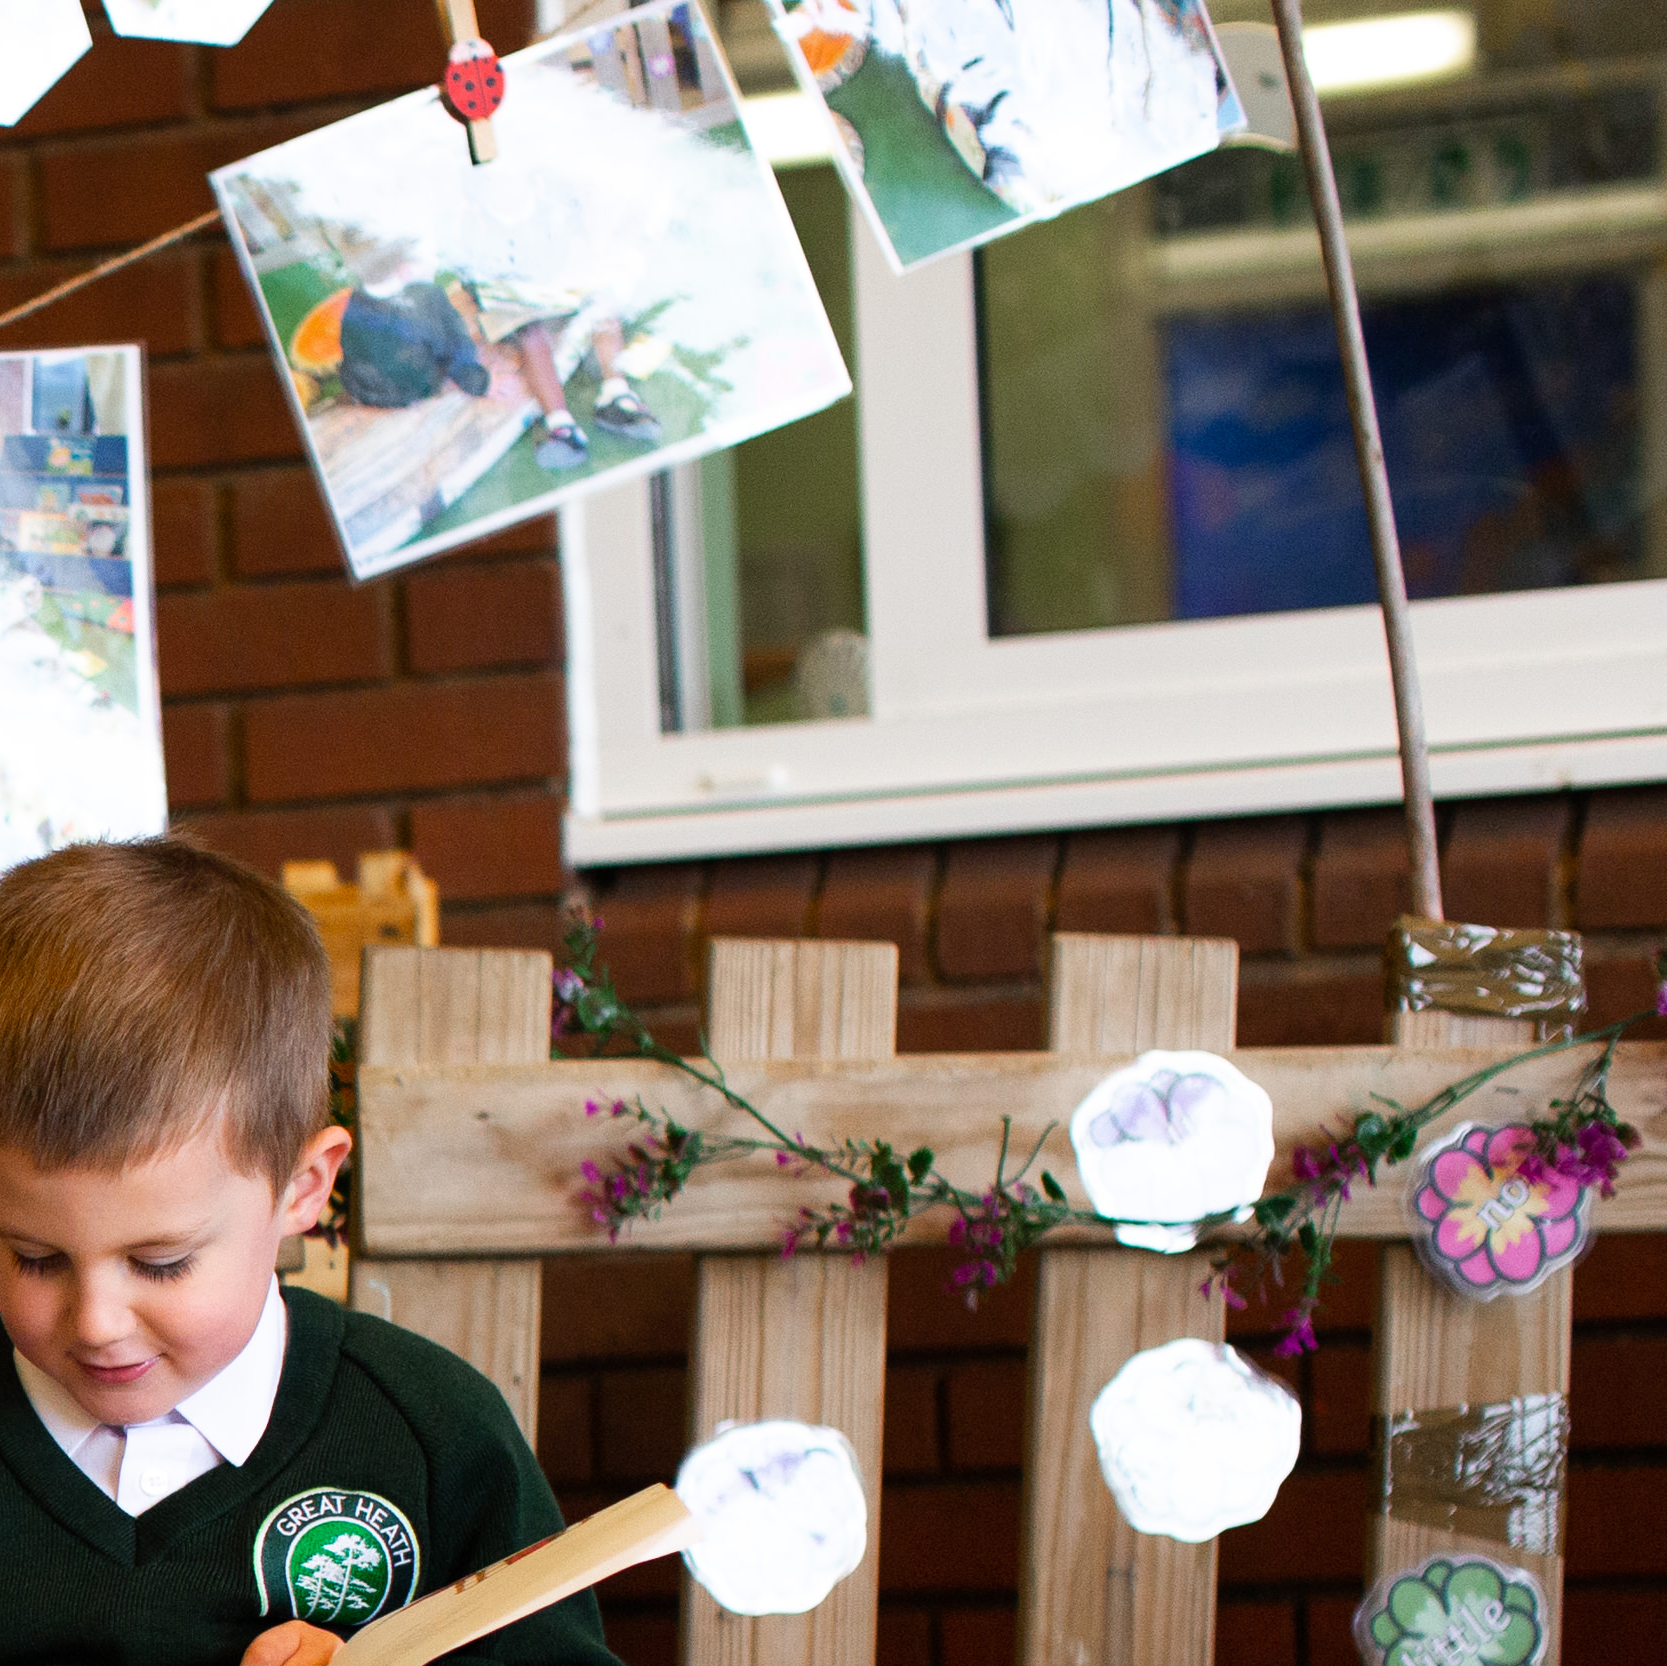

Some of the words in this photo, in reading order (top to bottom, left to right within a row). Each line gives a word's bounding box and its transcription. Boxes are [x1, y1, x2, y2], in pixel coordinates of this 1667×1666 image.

[1476, 1179, 1530, 1231] no
[276, 1495, 347, 1537] GREAT
[354, 1497, 413, 1568] HEATH
